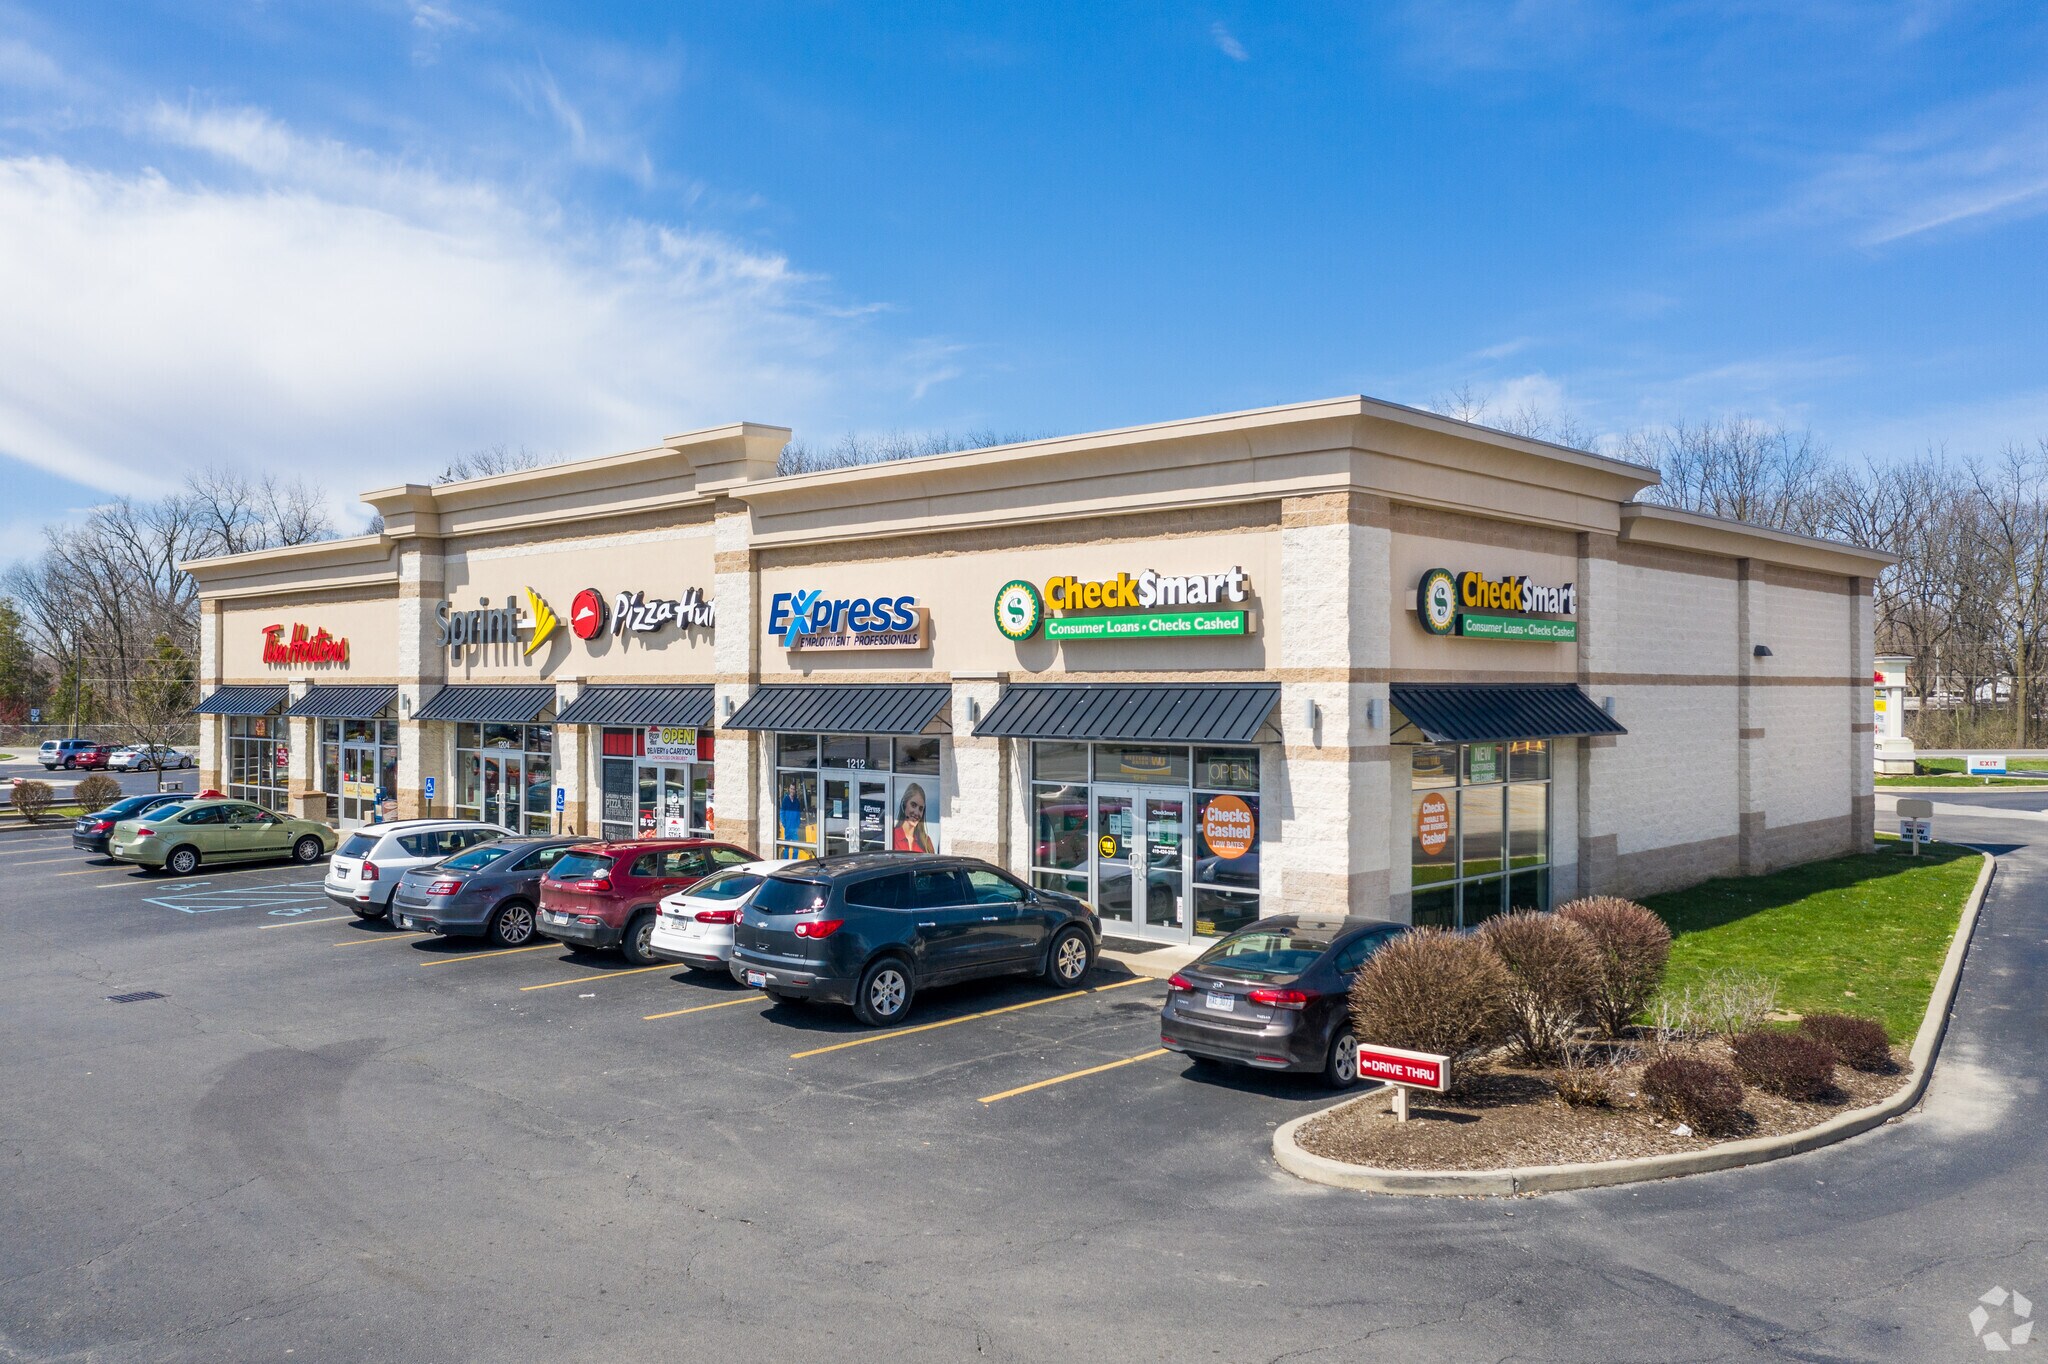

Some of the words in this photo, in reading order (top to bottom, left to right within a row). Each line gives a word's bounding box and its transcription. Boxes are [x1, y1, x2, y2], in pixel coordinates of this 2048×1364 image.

[611, 592, 672, 634] Pizza
[435, 595, 518, 660] Sprint
[1049, 622, 1104, 635] Consumer
[1106, 620, 1140, 633] Loans
[1148, 618, 1191, 631] Checks
[1194, 615, 1239, 629] Cashed
[1465, 619, 1502, 634] Consumer
[1503, 622, 1524, 635] Loans
[1528, 623, 1551, 636] Checks
[1552, 625, 1575, 638] Cashed
[262, 624, 288, 663] Tim
[289, 622, 346, 663] Hortons
[800, 635, 851, 648] EMPLOYMENT
[853, 633, 918, 646] PROFESSIONALS
[497, 740, 510, 749] 1204
[661, 727, 696, 746] OPEN!
[669, 748, 697, 756] CARRYOUT
[1474, 746, 1492, 761] NEW
[846, 758, 866, 769] 1212
[1209, 763, 1250, 780] OPEN
[1471, 762, 1496, 773] CUSTOMERS
[1206, 807, 1251, 823] Checks
[1422, 801, 1446, 814] Checks
[1206, 823, 1251, 839] Cashed
[1422, 831, 1446, 845] Cashed
[1212, 840, 1226, 848] LOW
[1226, 840, 1245, 849] RATES
[1372, 1060, 1403, 1076] DRIVE
[1405, 1065, 1435, 1081] THRU
